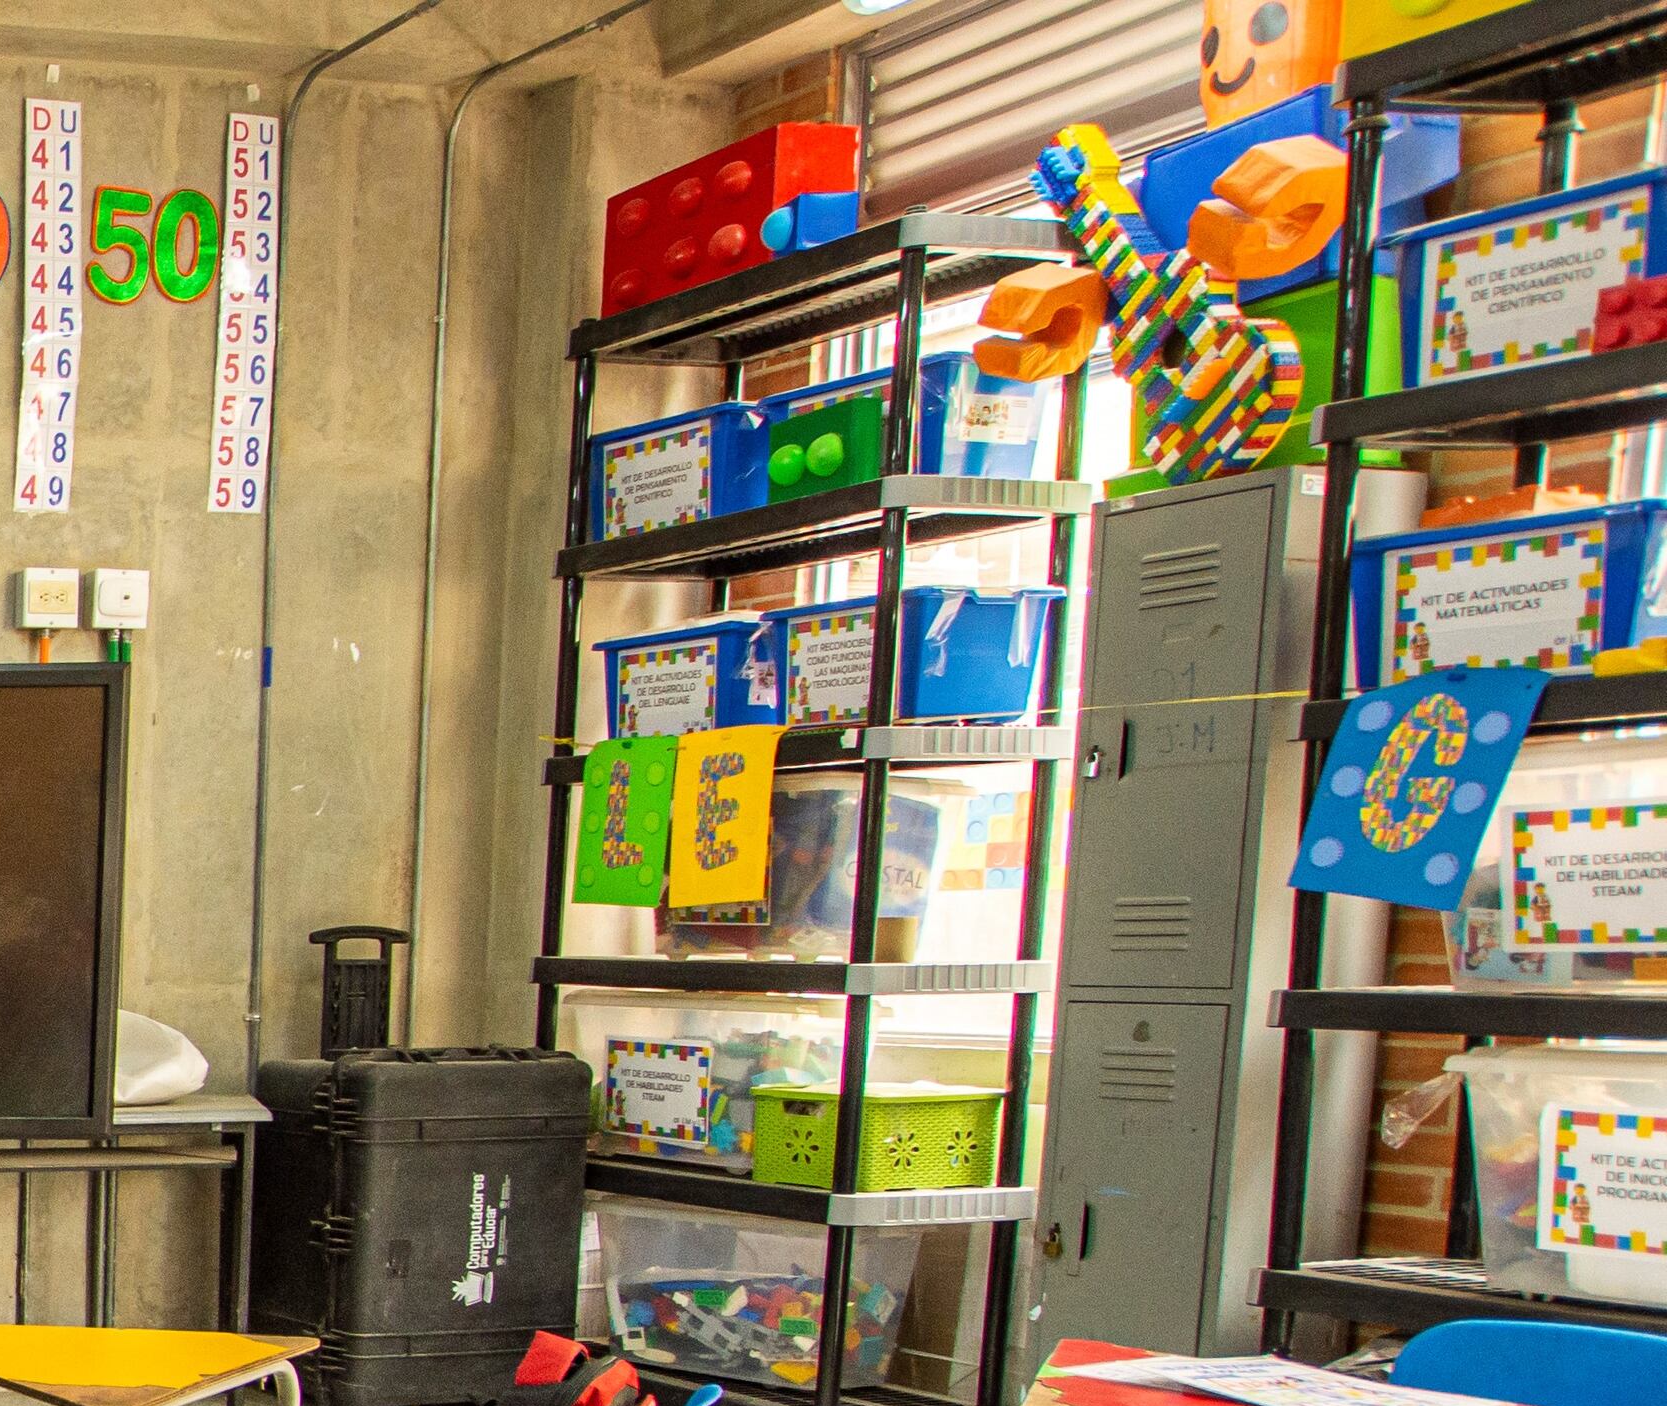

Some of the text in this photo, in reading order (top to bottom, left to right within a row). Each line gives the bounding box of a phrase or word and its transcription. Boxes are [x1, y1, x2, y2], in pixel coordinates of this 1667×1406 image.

[86, 185, 220, 305] 50
[1466, 248, 1605, 287] KIT DE DESARROLLO
[1471, 267, 1593, 302] DE PENSAMIENTO
[622, 462, 692, 484] KIT DE DESARROLLO
[625, 474, 686, 495] DE PENSAMIENTO
[1421, 578, 1569, 606] KIT DE ACTIVIDADES
[807, 645, 818, 653] KIT
[807, 656, 829, 665] COMO
[632, 670, 702, 685] KIT DE ACTIVIDADES
[814, 668, 827, 677] LAS
[637, 683, 696, 696] DE DESARROLLO
[639, 700, 651, 708] DEL
[1360, 693, 1469, 853] G
[602, 760, 645, 870] L
[697, 752, 746, 870] E
[1545, 856, 1565, 866] KIT
[1569, 855, 1587, 865] DE
[1557, 872, 1575, 882] DE
[1592, 886, 1641, 897] STEAM
[643, 1070, 690, 1082] DESARROLLO
[626, 1080, 683, 1092] DE HABILIDADES
[642, 1093, 664, 1101] STEAM
[1592, 1154, 1636, 1167] KIT DE
